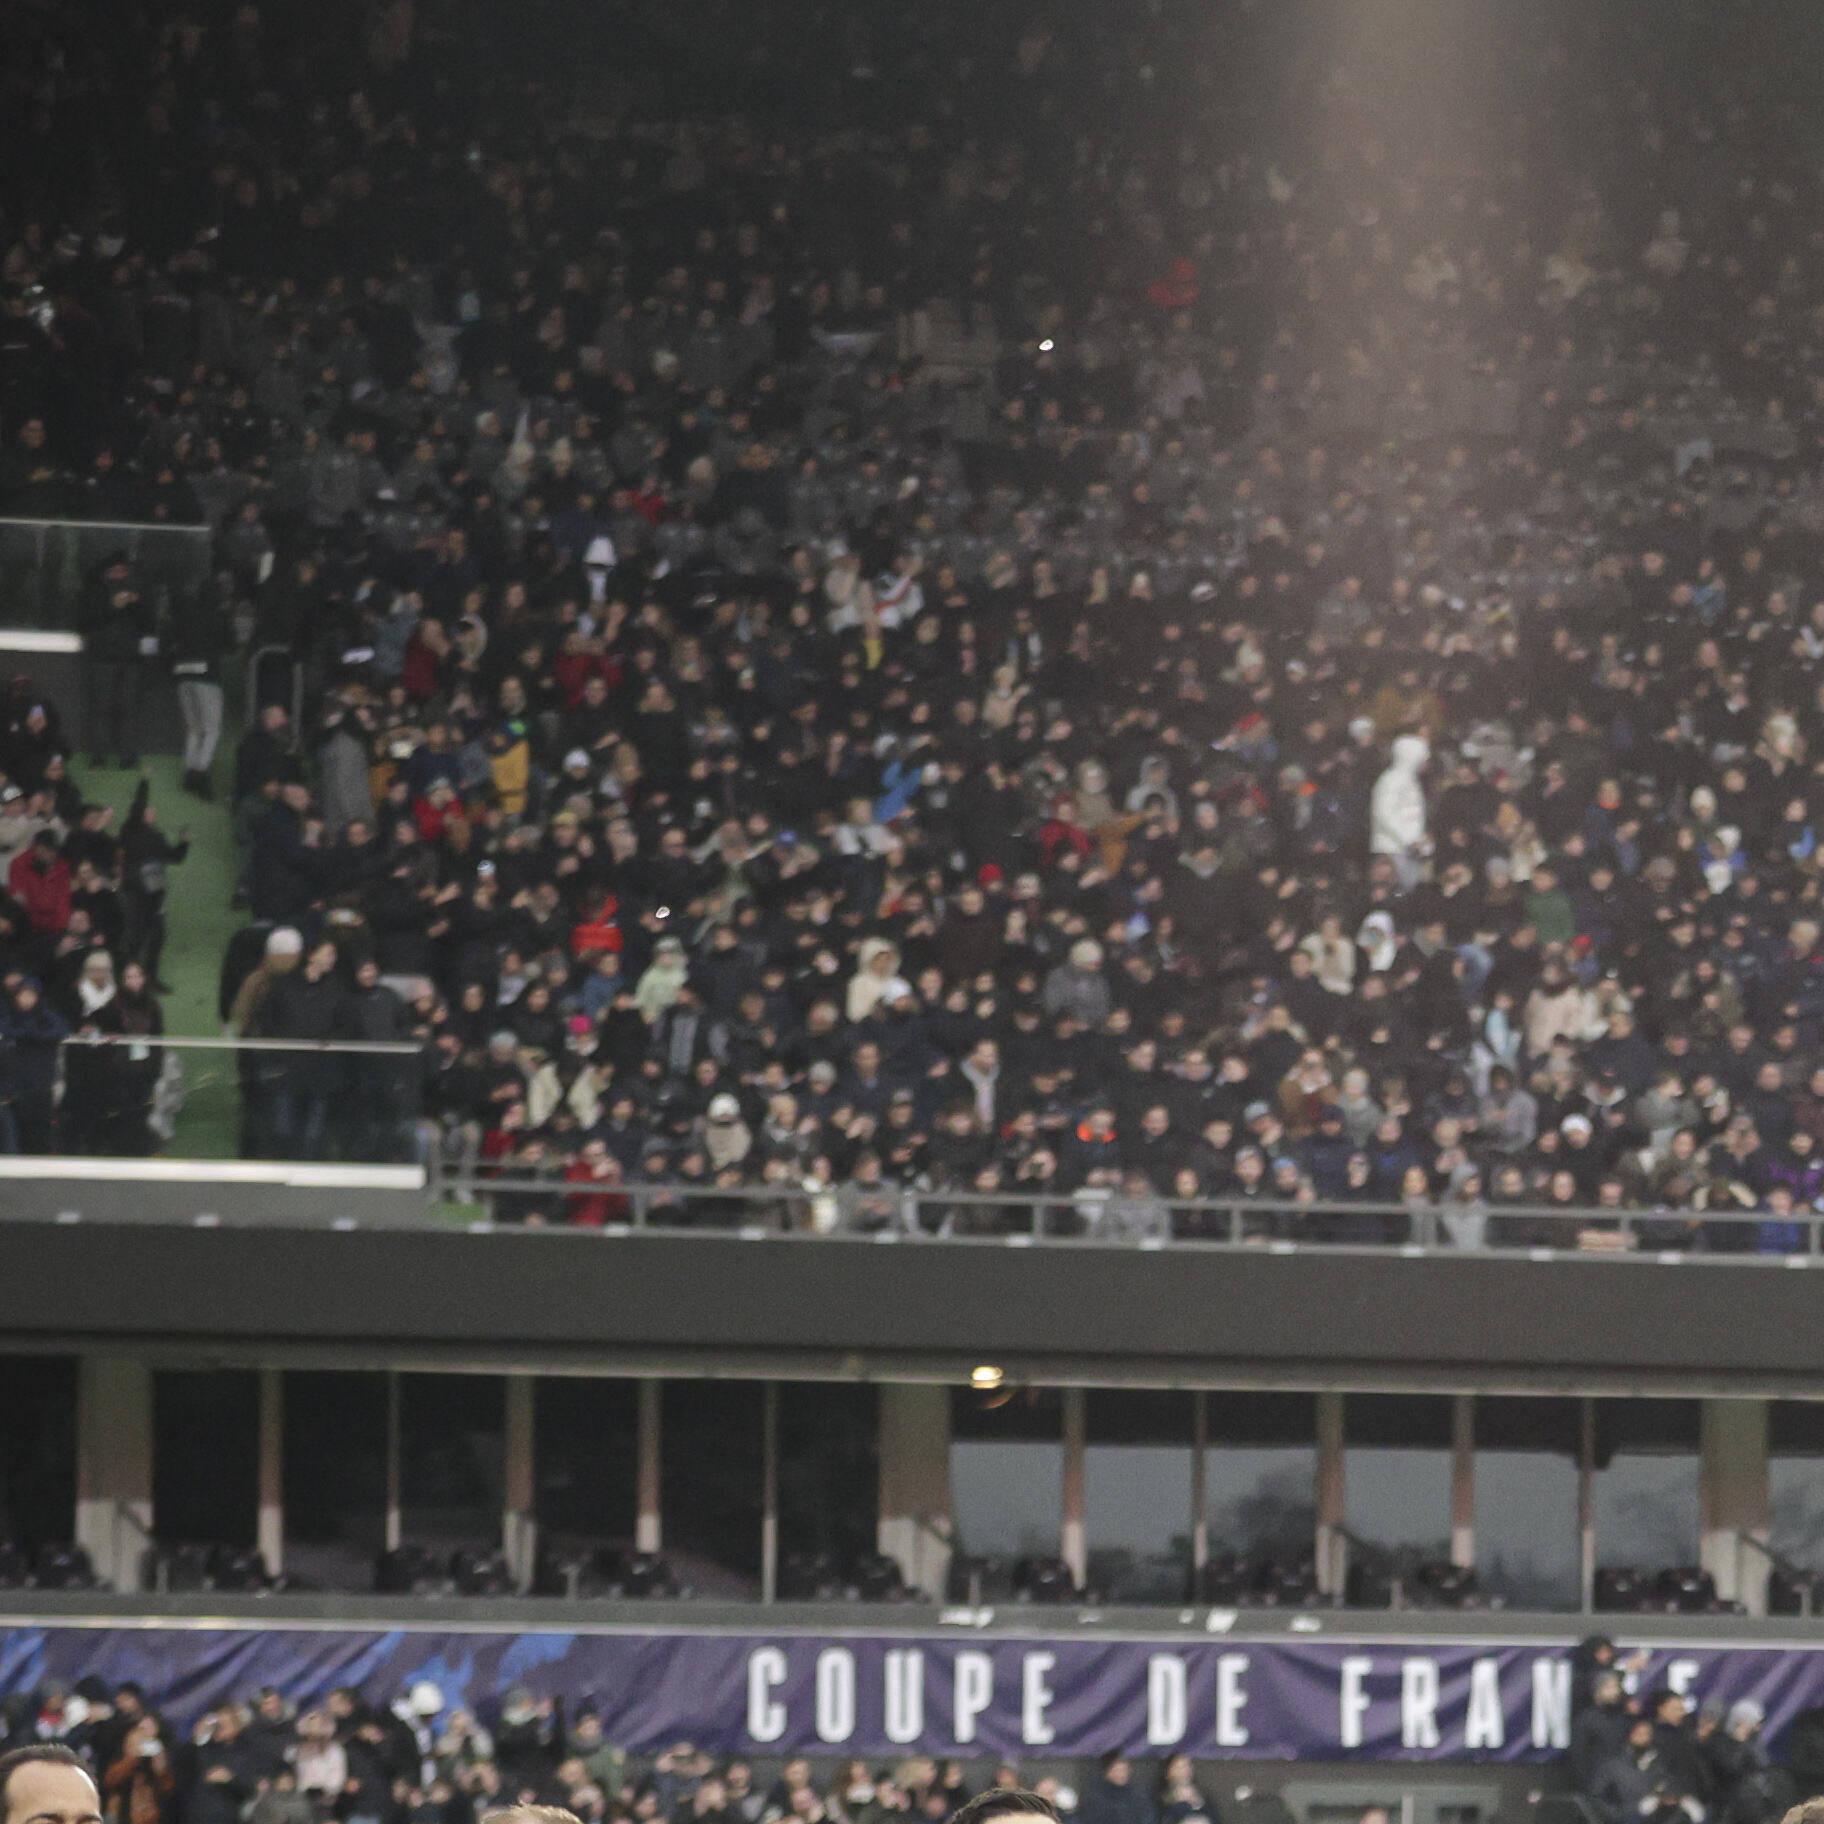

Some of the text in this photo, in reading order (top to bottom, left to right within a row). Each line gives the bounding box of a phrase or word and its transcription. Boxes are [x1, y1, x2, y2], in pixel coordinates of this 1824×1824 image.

[747, 1645, 1698, 1750] COUPE DE FRAN
